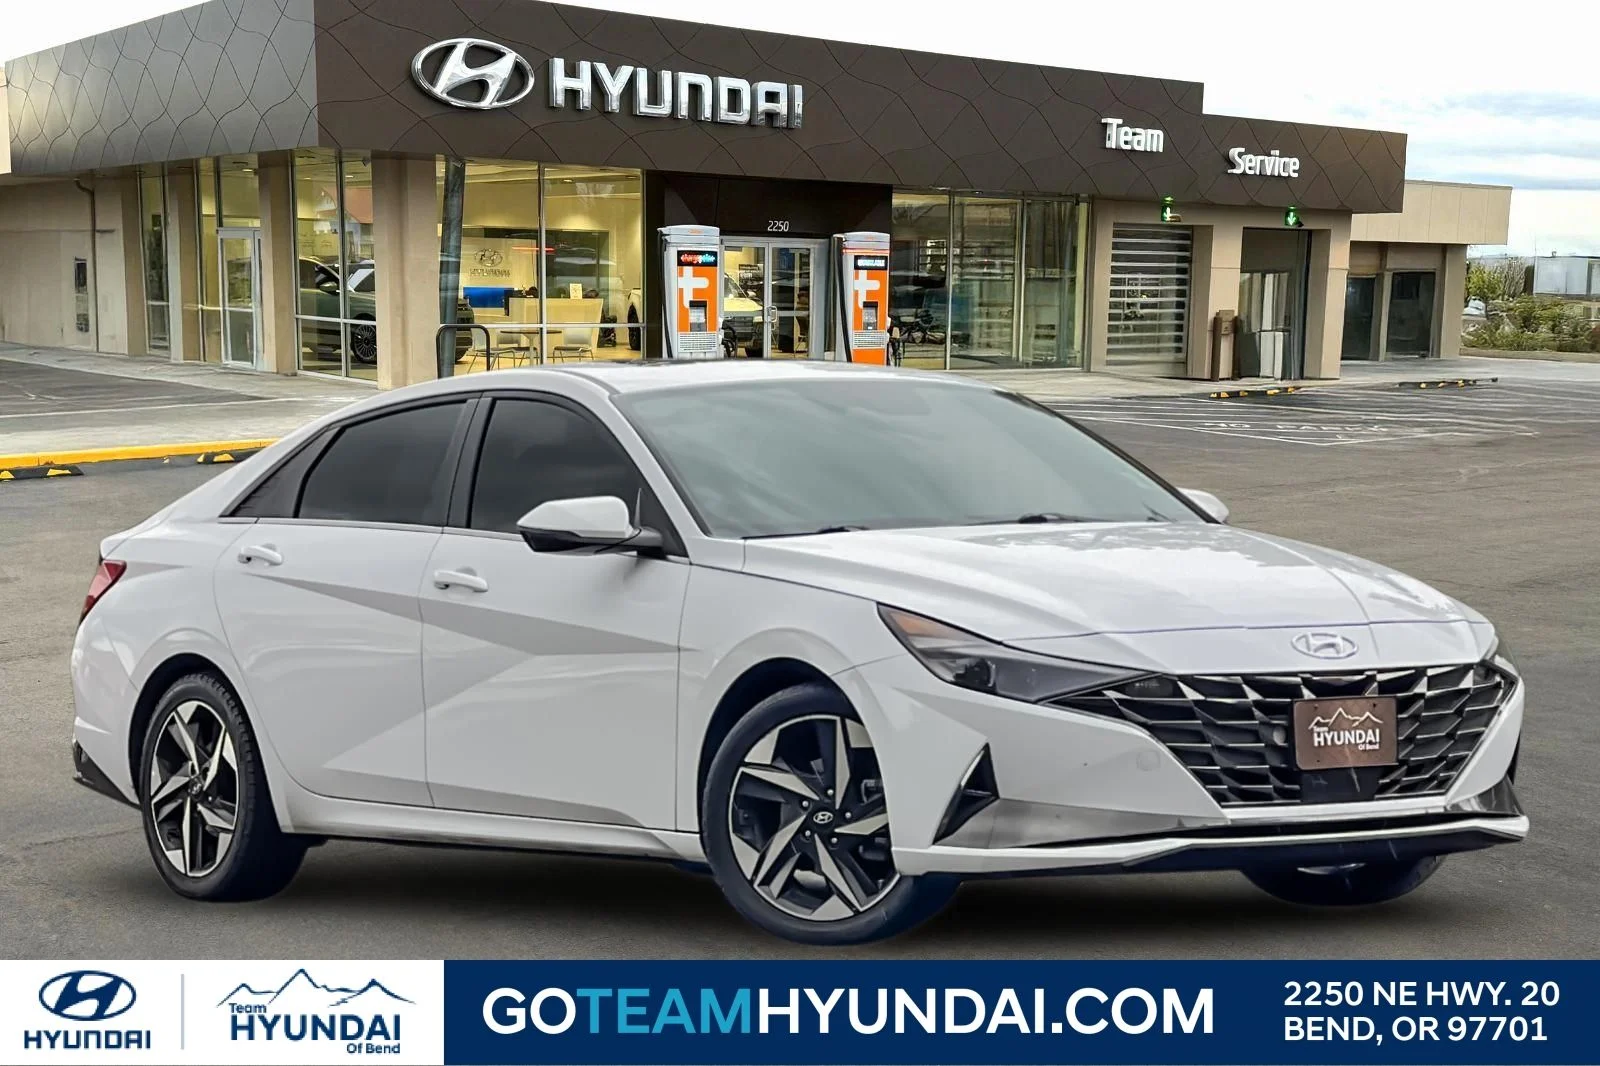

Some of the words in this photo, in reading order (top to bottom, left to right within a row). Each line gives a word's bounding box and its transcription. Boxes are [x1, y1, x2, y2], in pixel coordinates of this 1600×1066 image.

[549, 57, 804, 128] HYUNDAI
[1101, 117, 1164, 153] Team
[1227, 147, 1300, 178] Service
[767, 220, 790, 232] 2250
[1313, 728, 1380, 747] HYUNDAI
